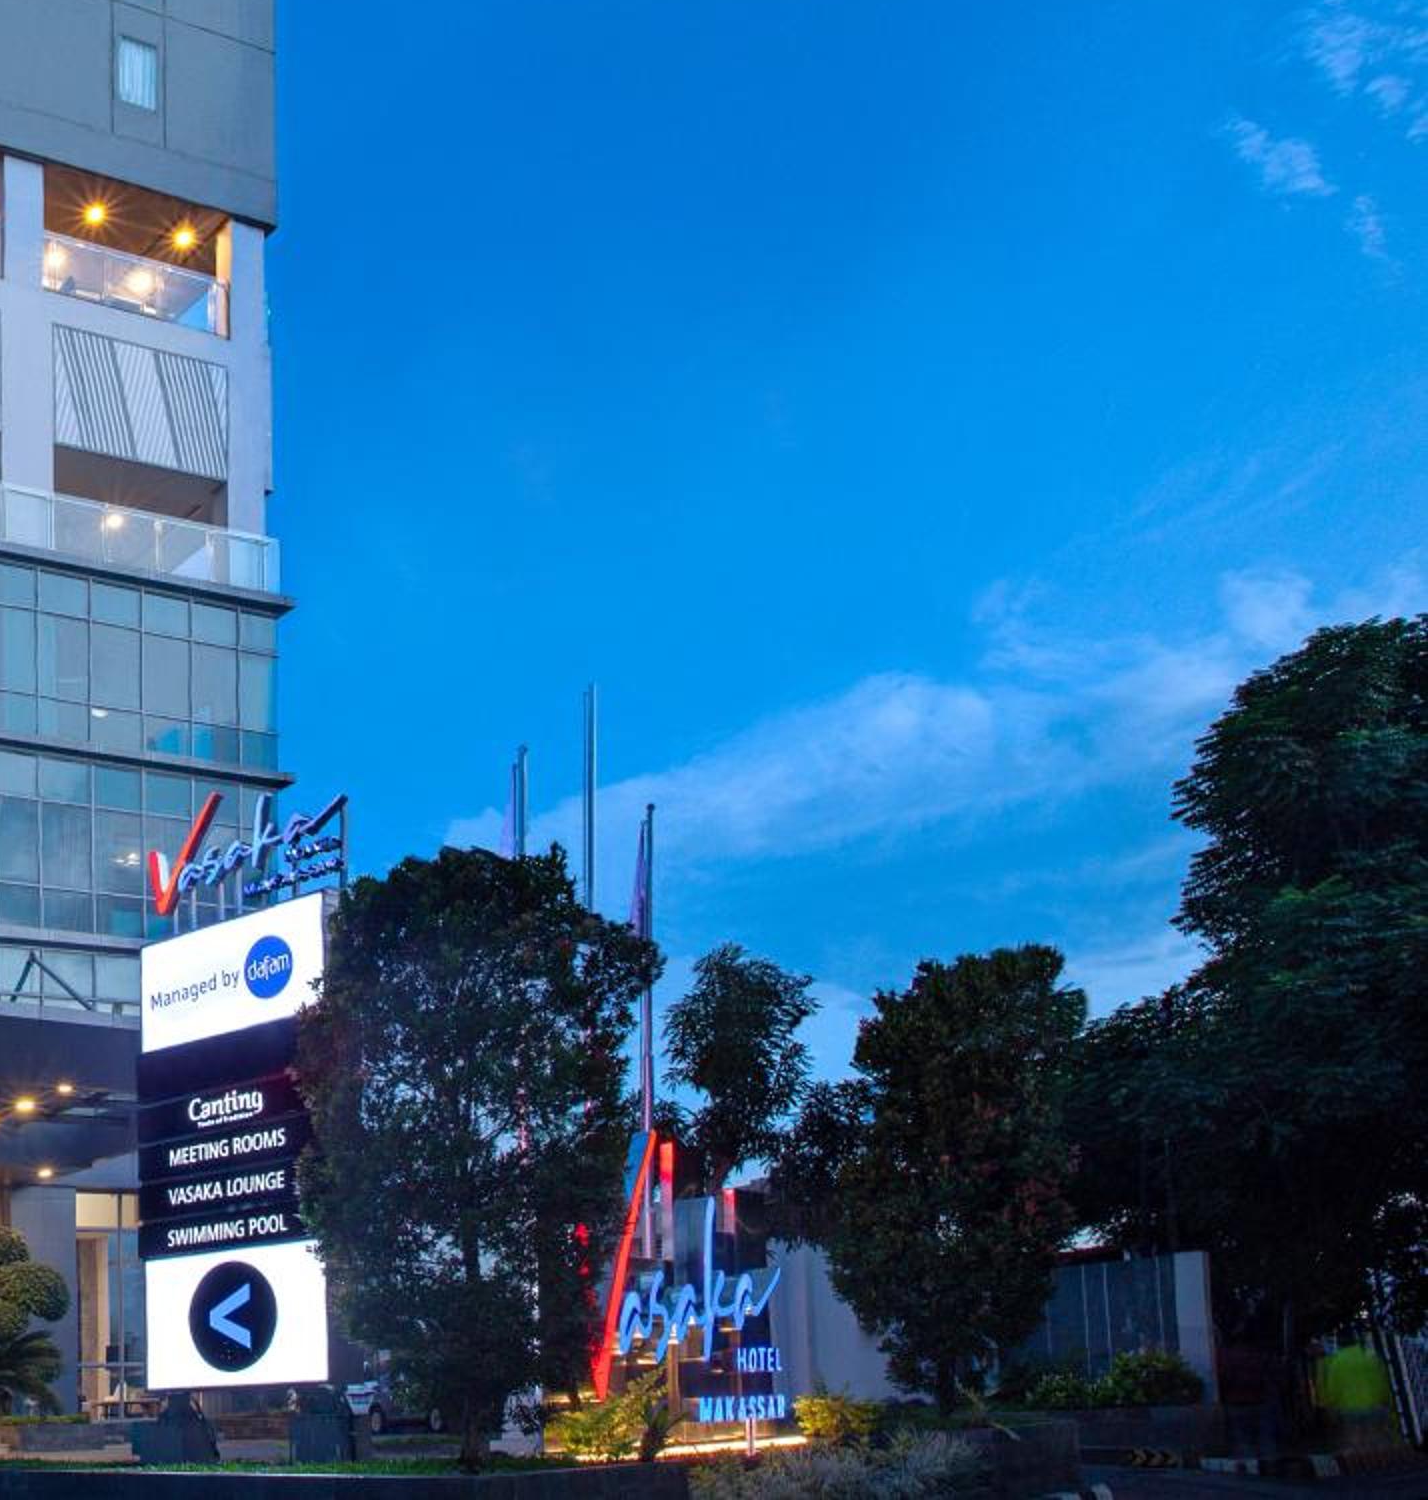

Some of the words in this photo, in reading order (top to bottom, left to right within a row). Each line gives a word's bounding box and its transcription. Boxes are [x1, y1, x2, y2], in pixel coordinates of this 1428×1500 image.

[148, 791, 349, 916] Vasaka
[150, 972, 217, 1011] Managed
[222, 969, 240, 989] by
[247, 953, 290, 981] dafam
[188, 1089, 263, 1121] Canting
[169, 1138, 230, 1168] MEETING
[233, 1127, 286, 1155] ROOMS
[168, 1181, 223, 1206] VASAKA
[227, 1170, 285, 1197] LOUNGE
[167, 1219, 245, 1248] SWIMMING
[248, 1213, 289, 1237] POOL
[736, 1346, 783, 1373] HOTEL
[698, 1394, 786, 1423] MAKASSAR
